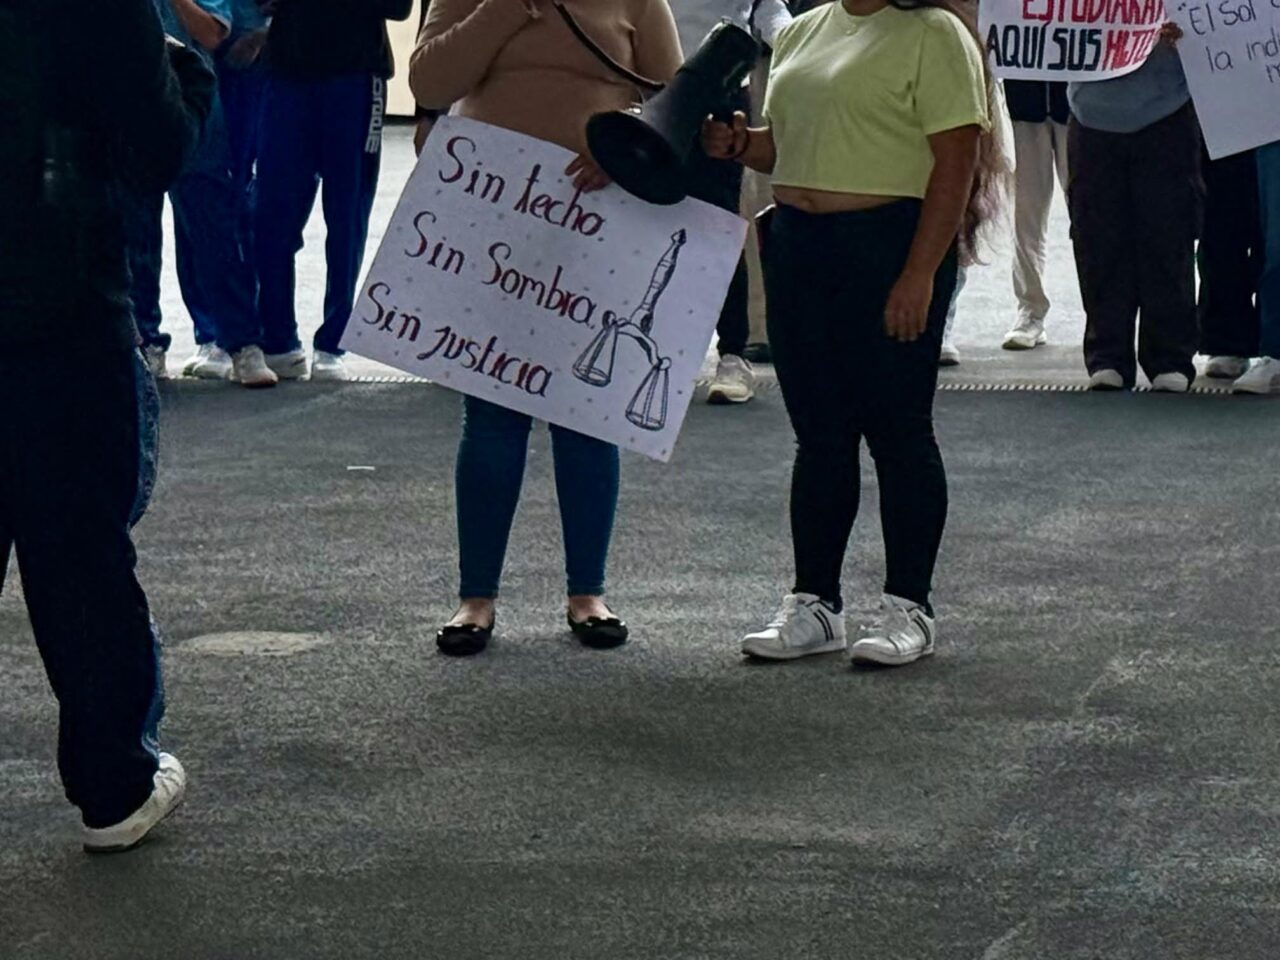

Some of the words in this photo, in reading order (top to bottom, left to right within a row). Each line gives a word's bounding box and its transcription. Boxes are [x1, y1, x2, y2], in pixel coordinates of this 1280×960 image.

[1047, 27, 1102, 71] SUS
[1205, 45, 1234, 73] la
[438, 136, 506, 204] Sin
[404, 210, 466, 275] Sin
[361, 281, 422, 341] Sin
